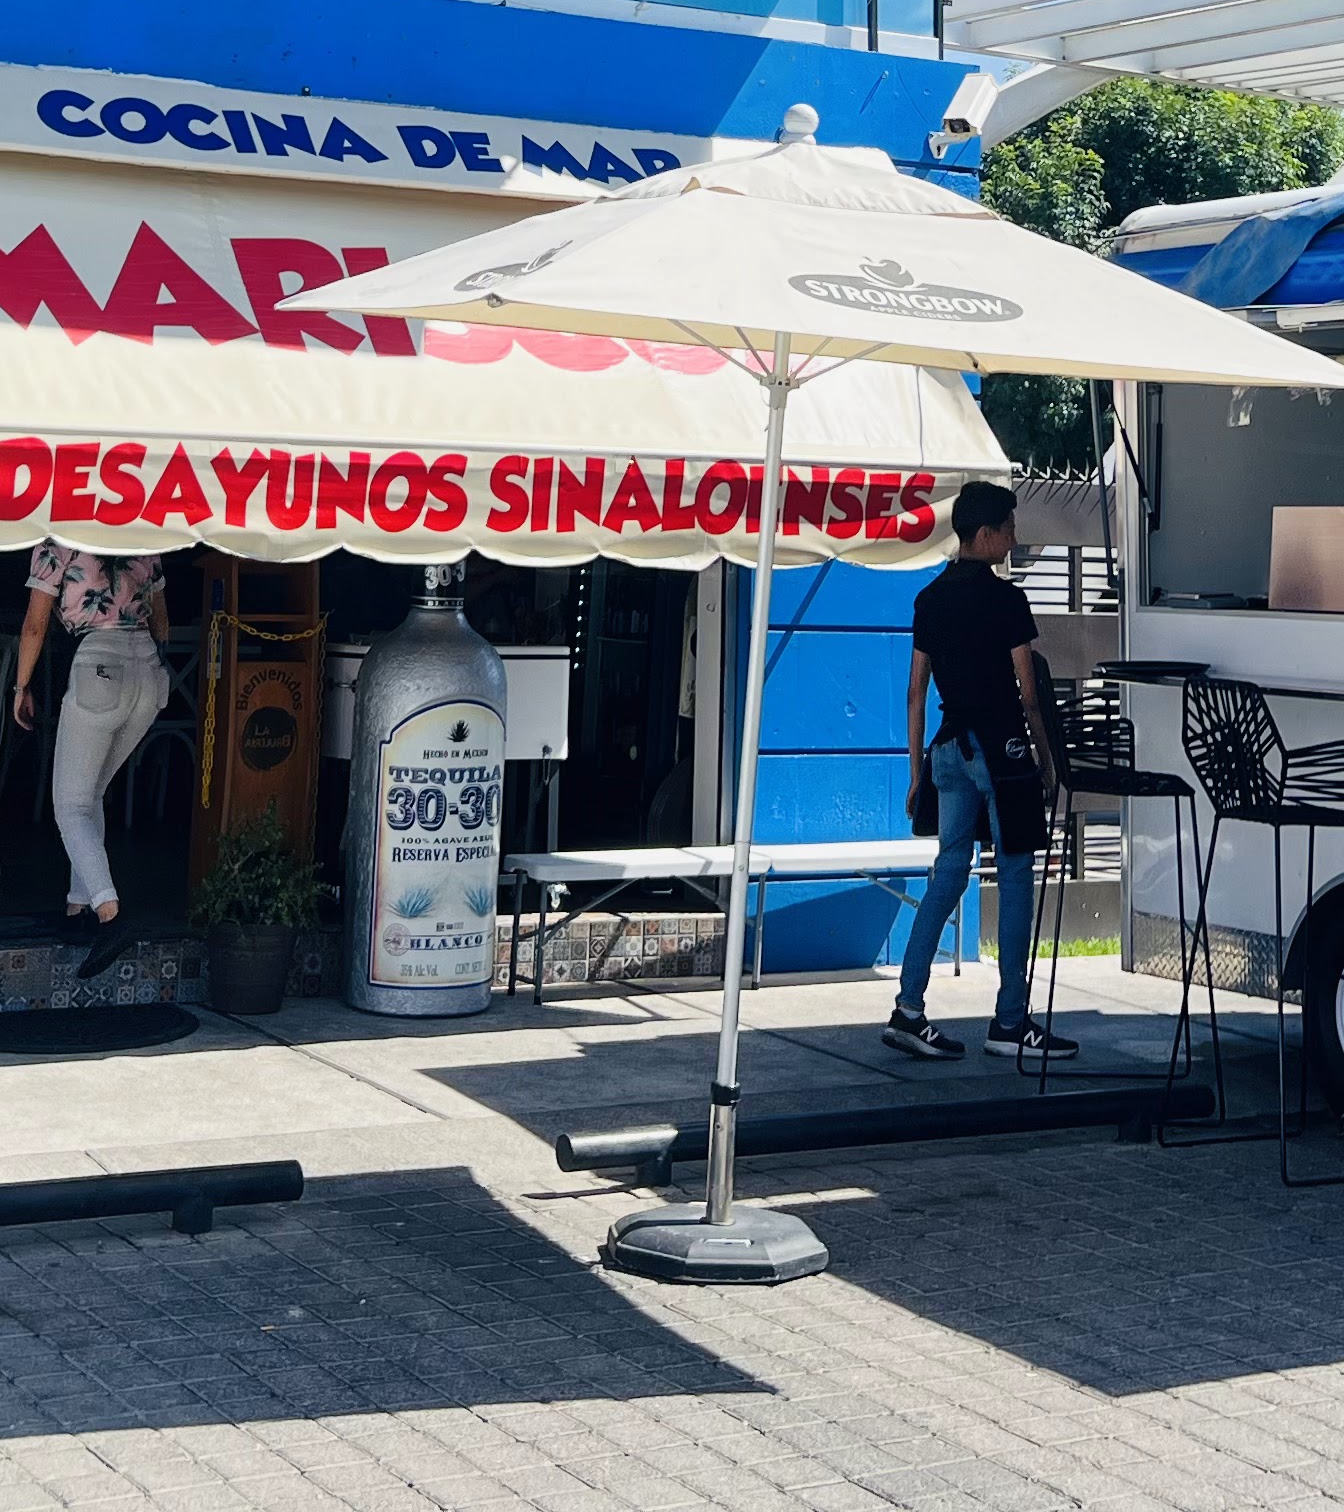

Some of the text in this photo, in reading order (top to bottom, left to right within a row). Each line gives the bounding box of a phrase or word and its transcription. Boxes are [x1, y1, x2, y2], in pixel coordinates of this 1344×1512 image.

[37, 90, 388, 164] COCINA
[396, 125, 504, 172] DE
[805, 279, 1003, 315] STRONGBOW
[389, 764, 502, 786] TEQUILA
[385, 783, 501, 832] 30-30
[392, 847, 449, 863] RESERVA
